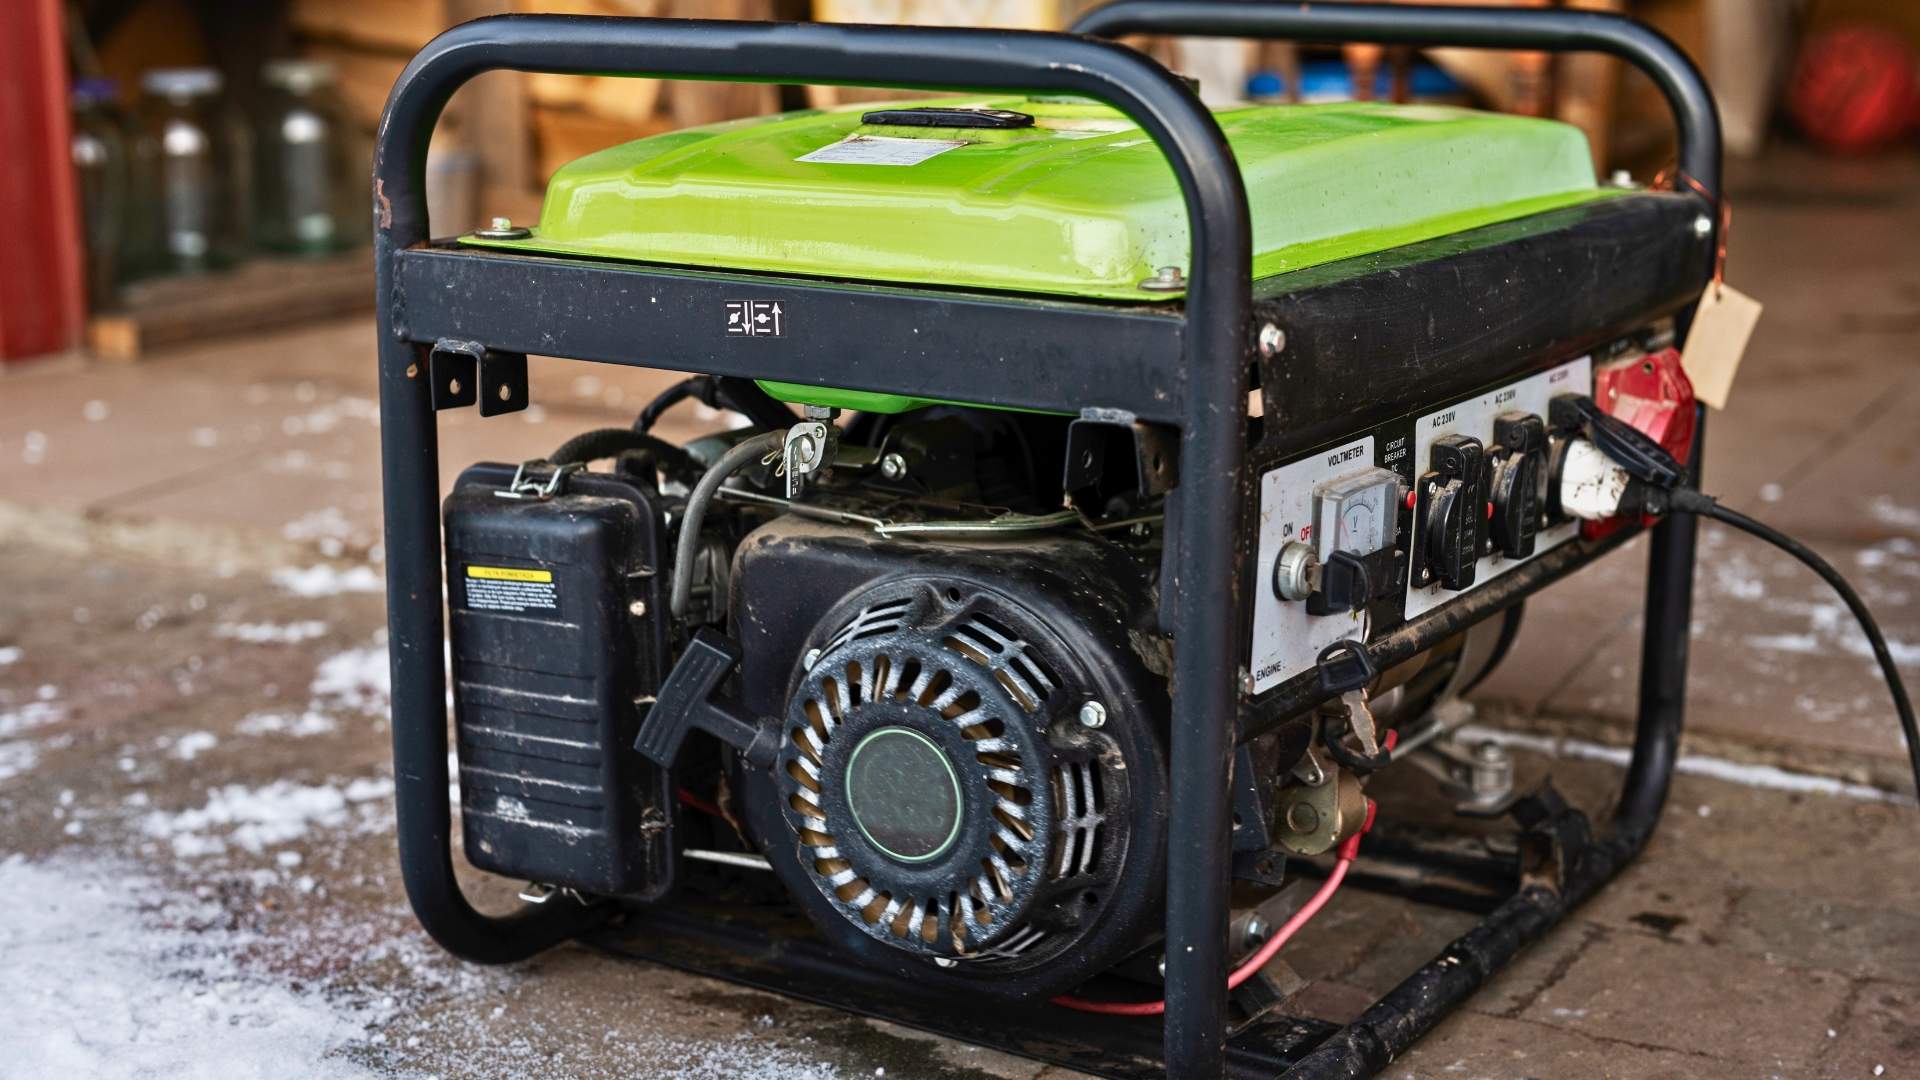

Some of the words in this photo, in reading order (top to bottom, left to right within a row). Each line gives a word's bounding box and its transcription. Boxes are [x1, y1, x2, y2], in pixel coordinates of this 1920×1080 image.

[1495, 395, 1503, 405] AC
[1503, 389, 1517, 403] 230V
[1432, 416, 1441, 428] AC
[1442, 411, 1456, 425] 230V
[1385, 437, 1405, 452] CIRCUIT
[1327, 445, 1364, 467] VOLTMETER
[1384, 448, 1407, 464] BREAKER
[1282, 521, 1294, 537] ON
[1256, 660, 1282, 682] ENGINE
